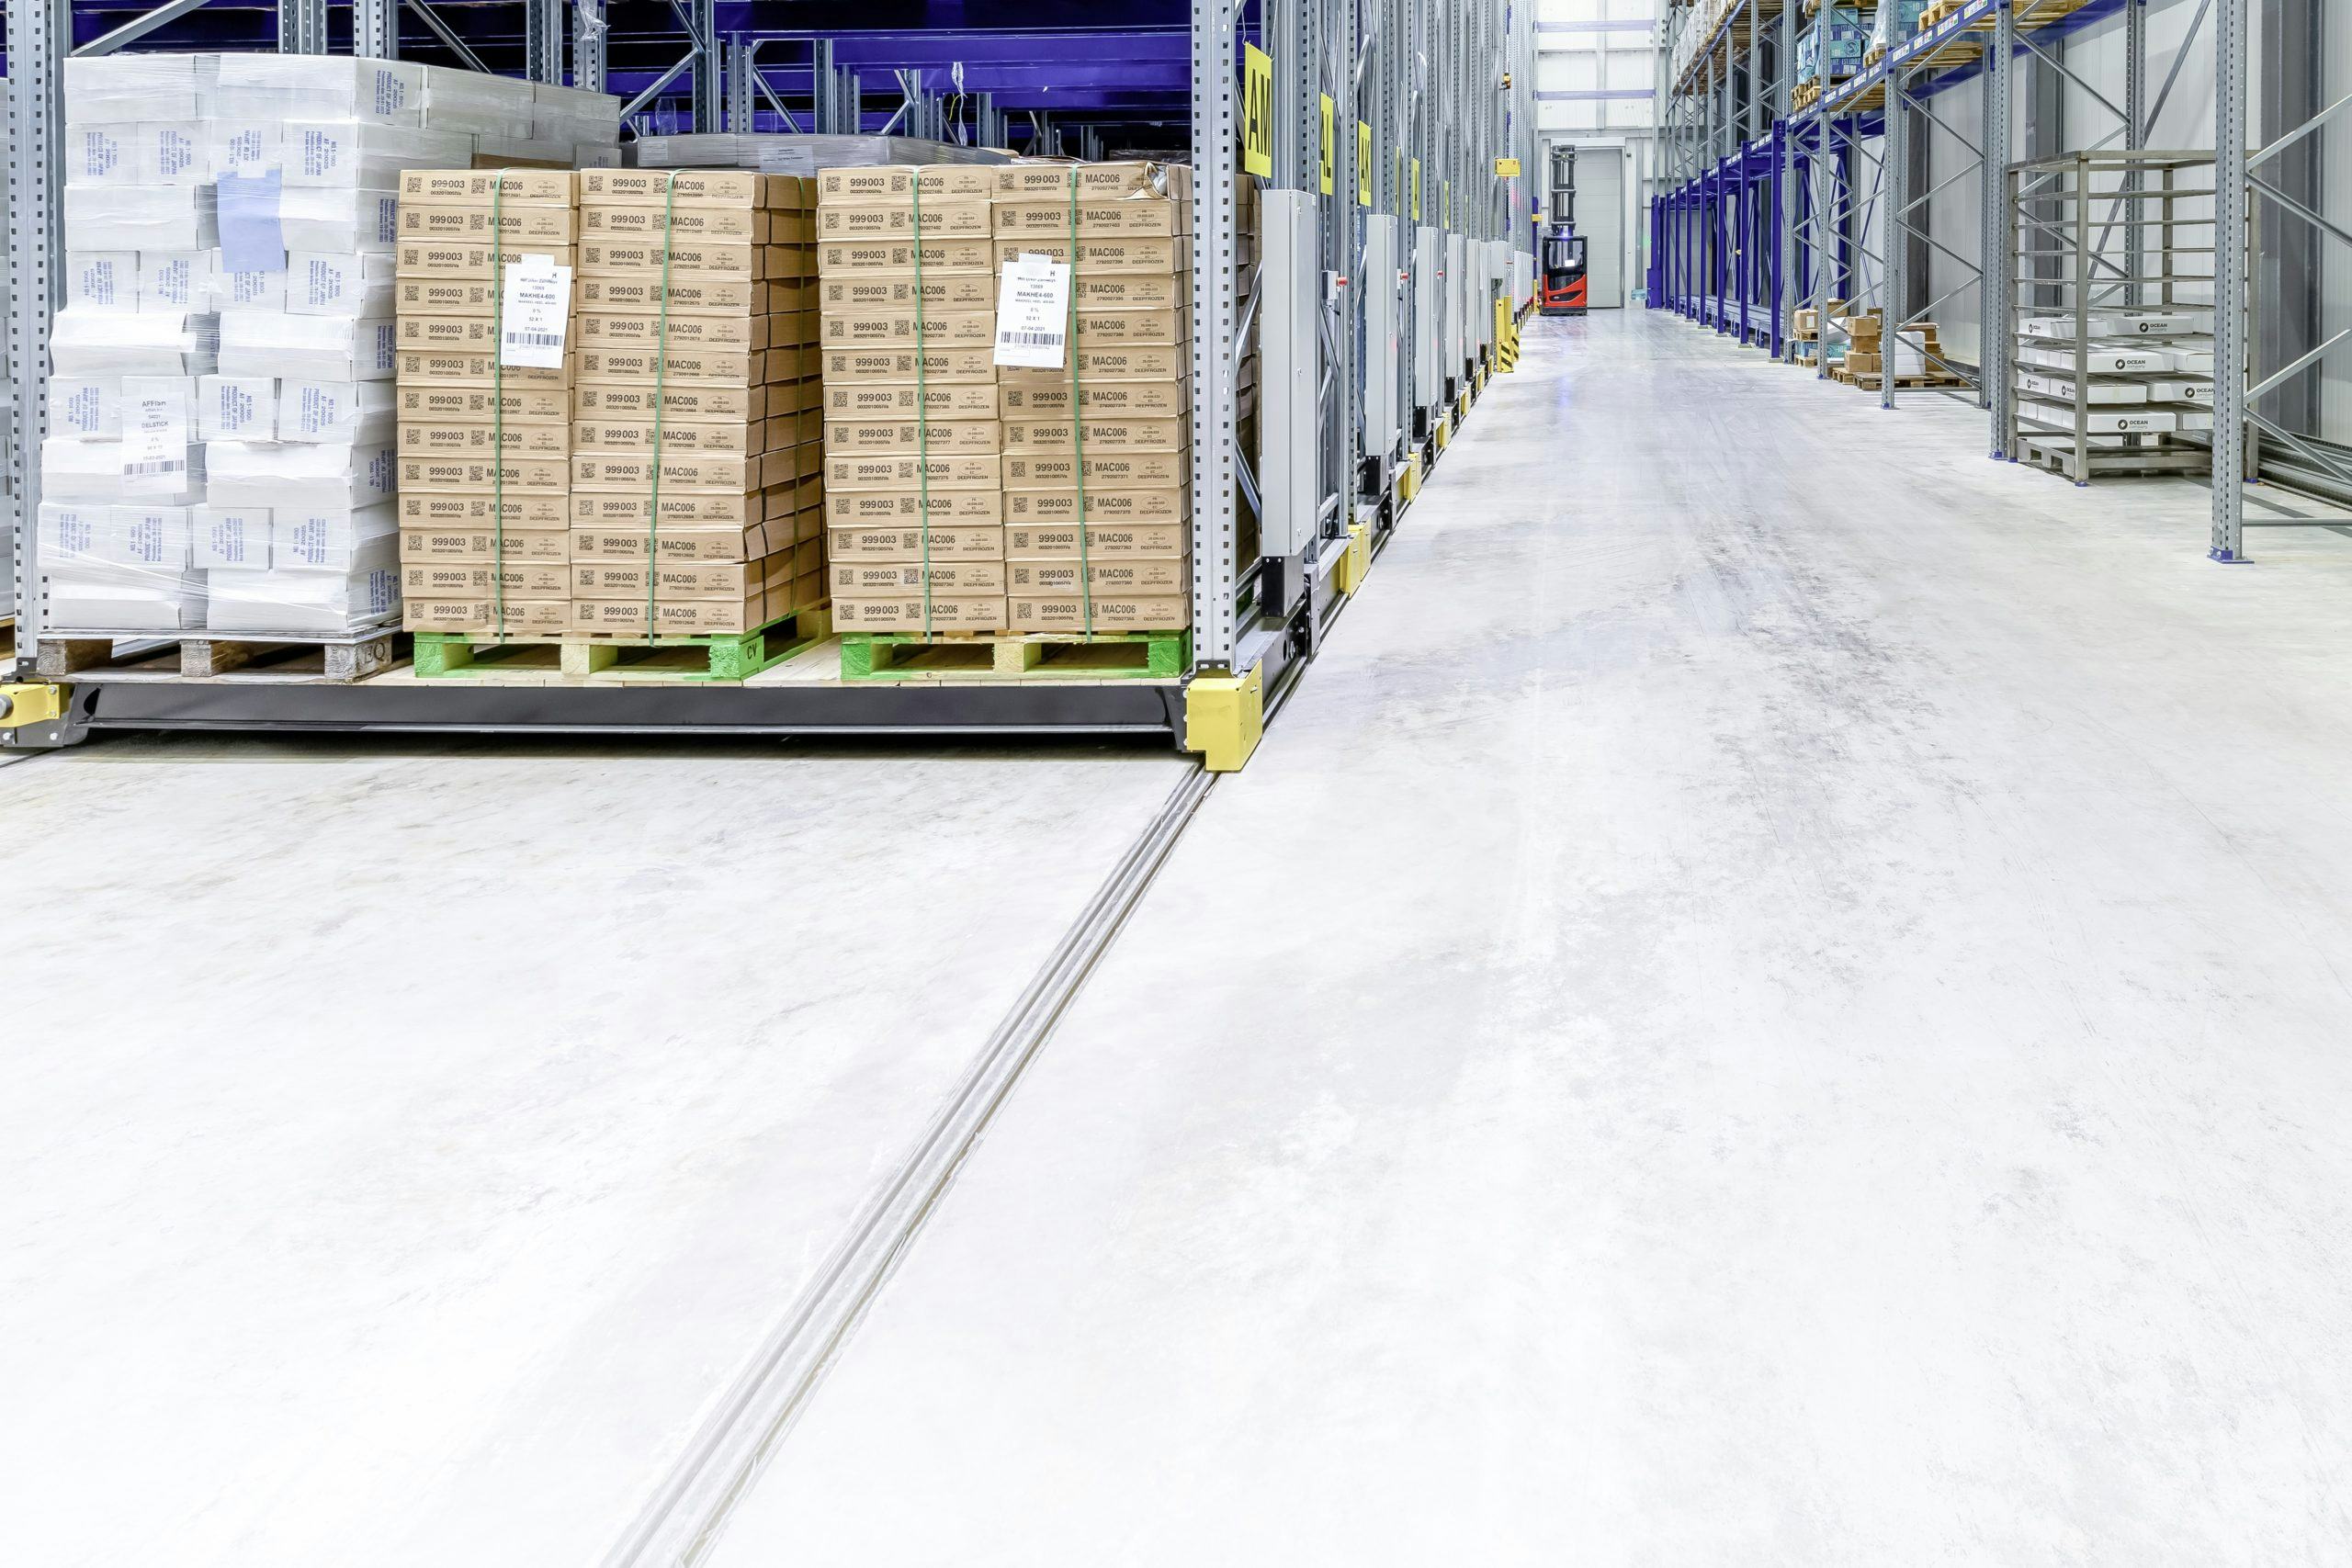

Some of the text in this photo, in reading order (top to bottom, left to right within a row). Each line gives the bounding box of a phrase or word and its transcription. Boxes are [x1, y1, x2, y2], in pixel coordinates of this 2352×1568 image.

[1248, 69, 1270, 157] AM
[1321, 110, 1331, 178] AL
[1360, 137, 1371, 193] AK
[1085, 174, 1121, 184] MAC006
[672, 180, 705, 191] MAC006
[1086, 210, 1122, 220] MAC006
[670, 216, 705, 227] MAC006
[667, 252, 702, 262] MAC006
[1089, 247, 1125, 257] MAC006
[667, 288, 702, 299] MAC006
[1090, 284, 1125, 294] MAC006
[668, 323, 703, 334] MAC006
[1090, 320, 1125, 330] MAC006
[667, 359, 702, 370] MAC006
[1091, 355, 1127, 366] MAC006
[663, 395, 698, 406] MAC006
[1092, 391, 1128, 401] MAC006
[662, 431, 696, 441] MAC006
[1092, 427, 1127, 437] MAC006
[663, 467, 698, 477] MAC006
[1095, 462, 1130, 472] MAC006
[661, 502, 695, 513] MAC006
[1097, 498, 1133, 508] MAC006
[1098, 533, 1134, 543] MAC006
[662, 540, 696, 551] MAC006
[662, 573, 697, 583] MAC006
[1099, 569, 1134, 579] MAC006
[662, 608, 697, 618] MAC006
[1102, 604, 1136, 615] MAC006
